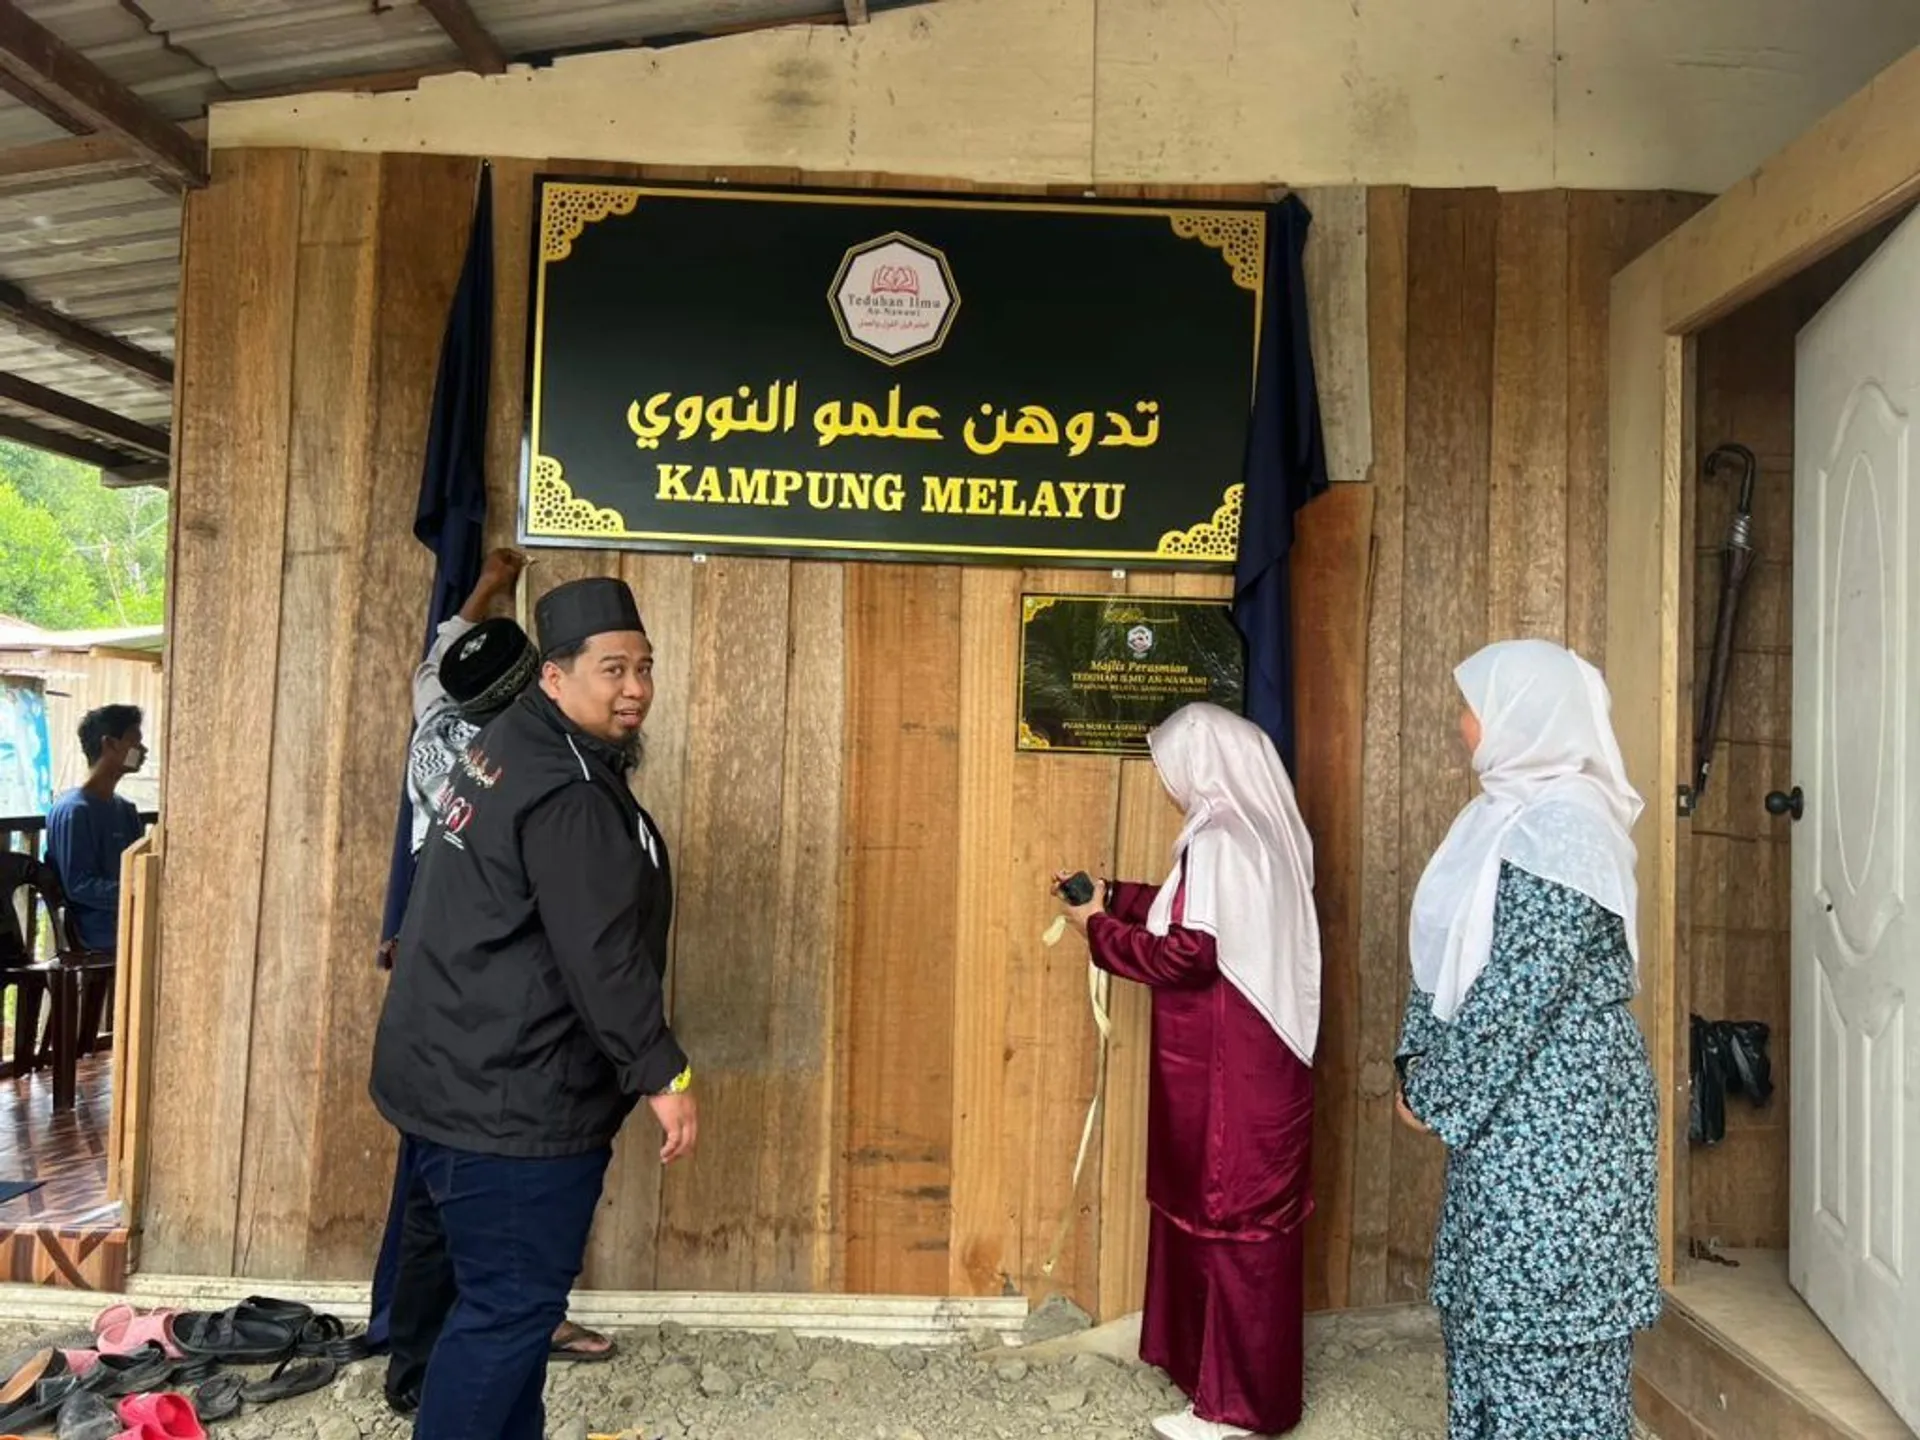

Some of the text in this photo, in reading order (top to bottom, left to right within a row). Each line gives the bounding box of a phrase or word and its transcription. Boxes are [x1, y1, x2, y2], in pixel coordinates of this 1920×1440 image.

[847, 294, 940, 309] Teduhan Ilmu
[626, 379, 1160, 457] تدوهن علمو النووي
[656, 463, 1126, 521] KAMPUNG MELAYU
